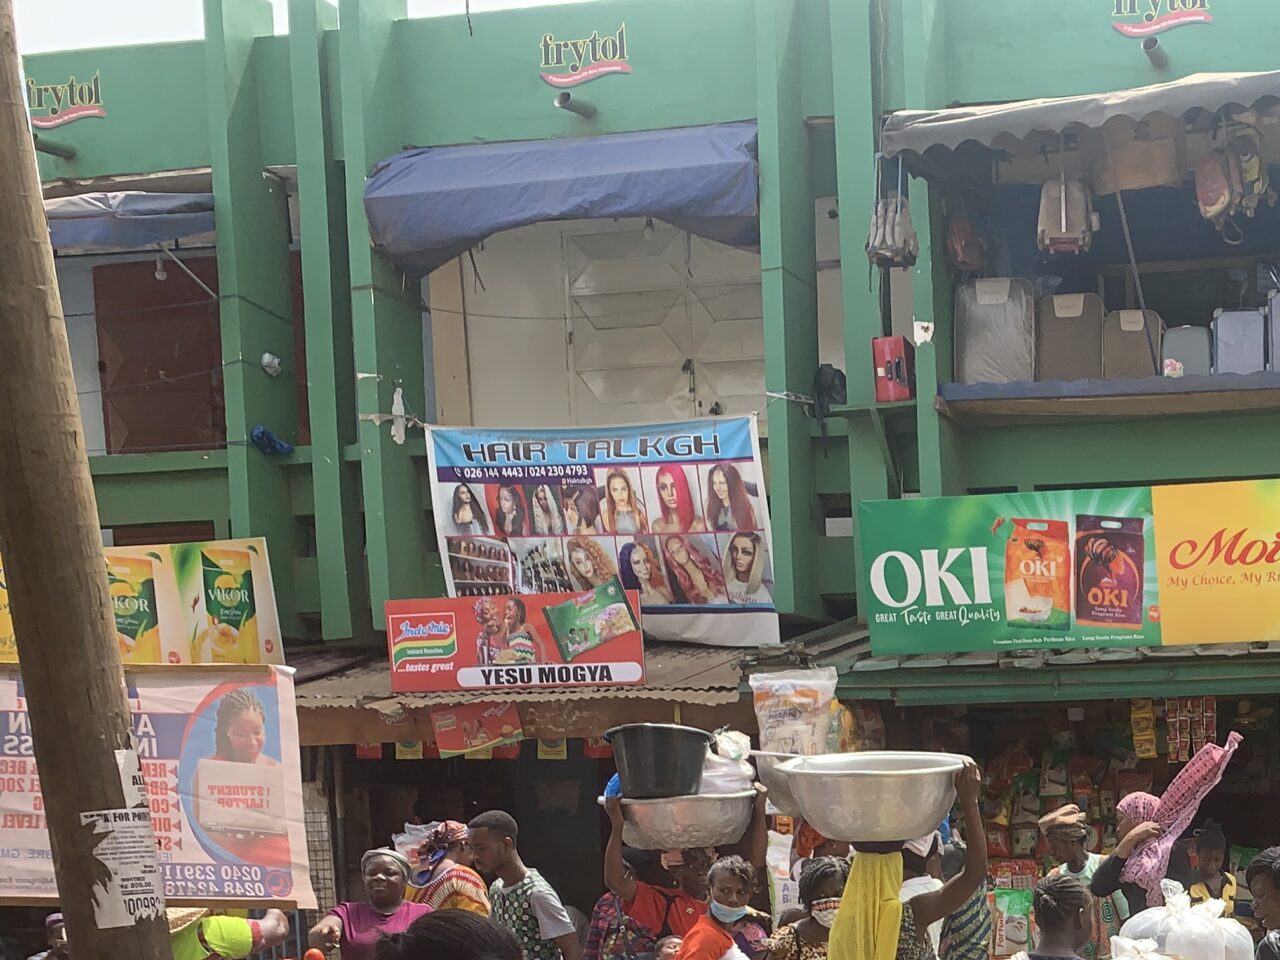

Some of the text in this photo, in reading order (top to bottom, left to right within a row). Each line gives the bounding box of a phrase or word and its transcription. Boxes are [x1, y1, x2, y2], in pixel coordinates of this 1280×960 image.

[540, 21, 628, 72] frytol
[462, 433, 720, 463] HAIR TALKGH
[464, 467, 483, 479] 026
[485, 467, 499, 479] 144
[501, 466, 524, 478] 4443
[529, 466, 546, 477] 024
[547, 466, 564, 477] 230
[565, 464, 589, 476] 4793
[870, 546, 993, 608] OKI
[1020, 559, 1056, 577] OKI
[1166, 573, 1188, 590] My
[1193, 573, 1235, 586] Choice,
[1239, 572, 1262, 586] My
[208, 588, 249, 603] VIKOR
[1088, 587, 1128, 607] OKI
[875, 605, 1000, 626] GREAT Taste GREAT Quality
[431, 662, 454, 673] great
[481, 665, 613, 685] YESU MOGYA
[113, 811, 131, 822] FOR
